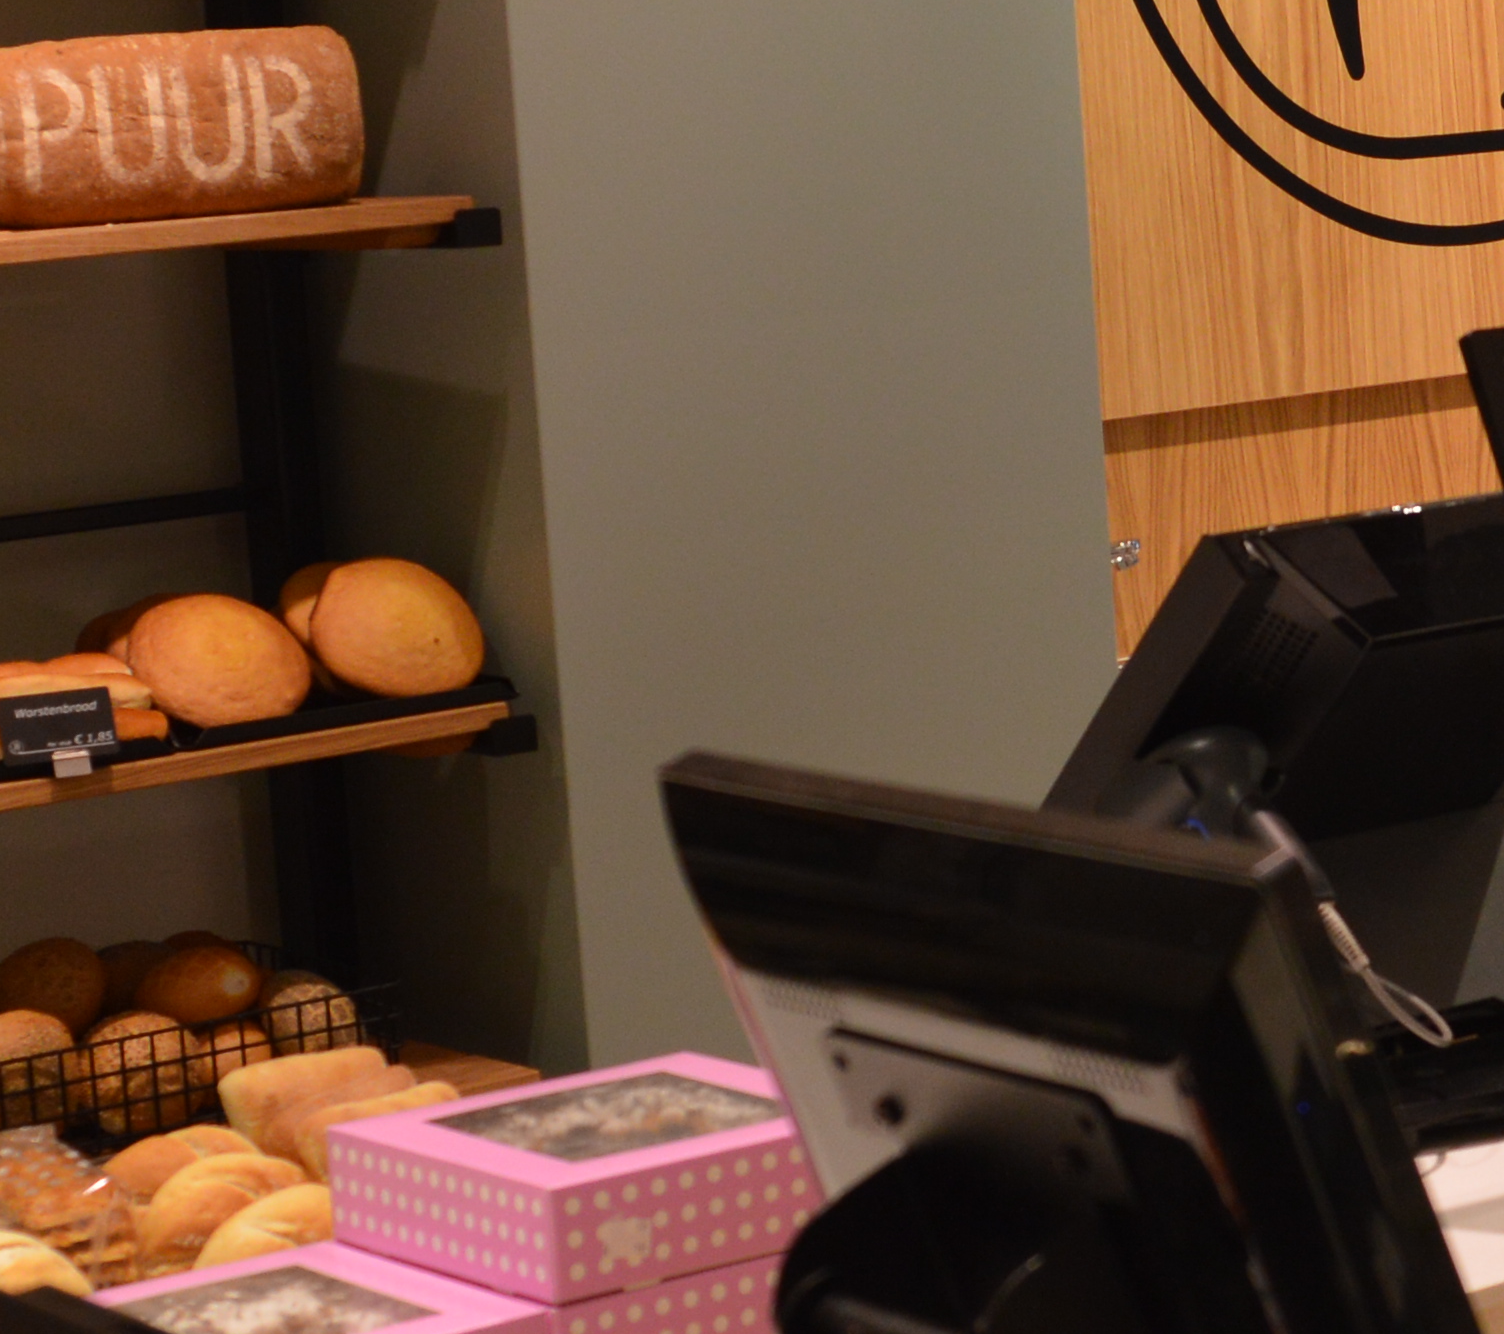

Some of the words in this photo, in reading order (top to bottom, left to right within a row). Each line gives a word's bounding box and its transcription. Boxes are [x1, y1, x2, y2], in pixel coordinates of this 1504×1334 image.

[18, 54, 314, 195] PUUR
[14, 700, 97, 719] Worstenbrood
[74, 734, 83, 745] €
[86, 730, 113, 743] 1,85
